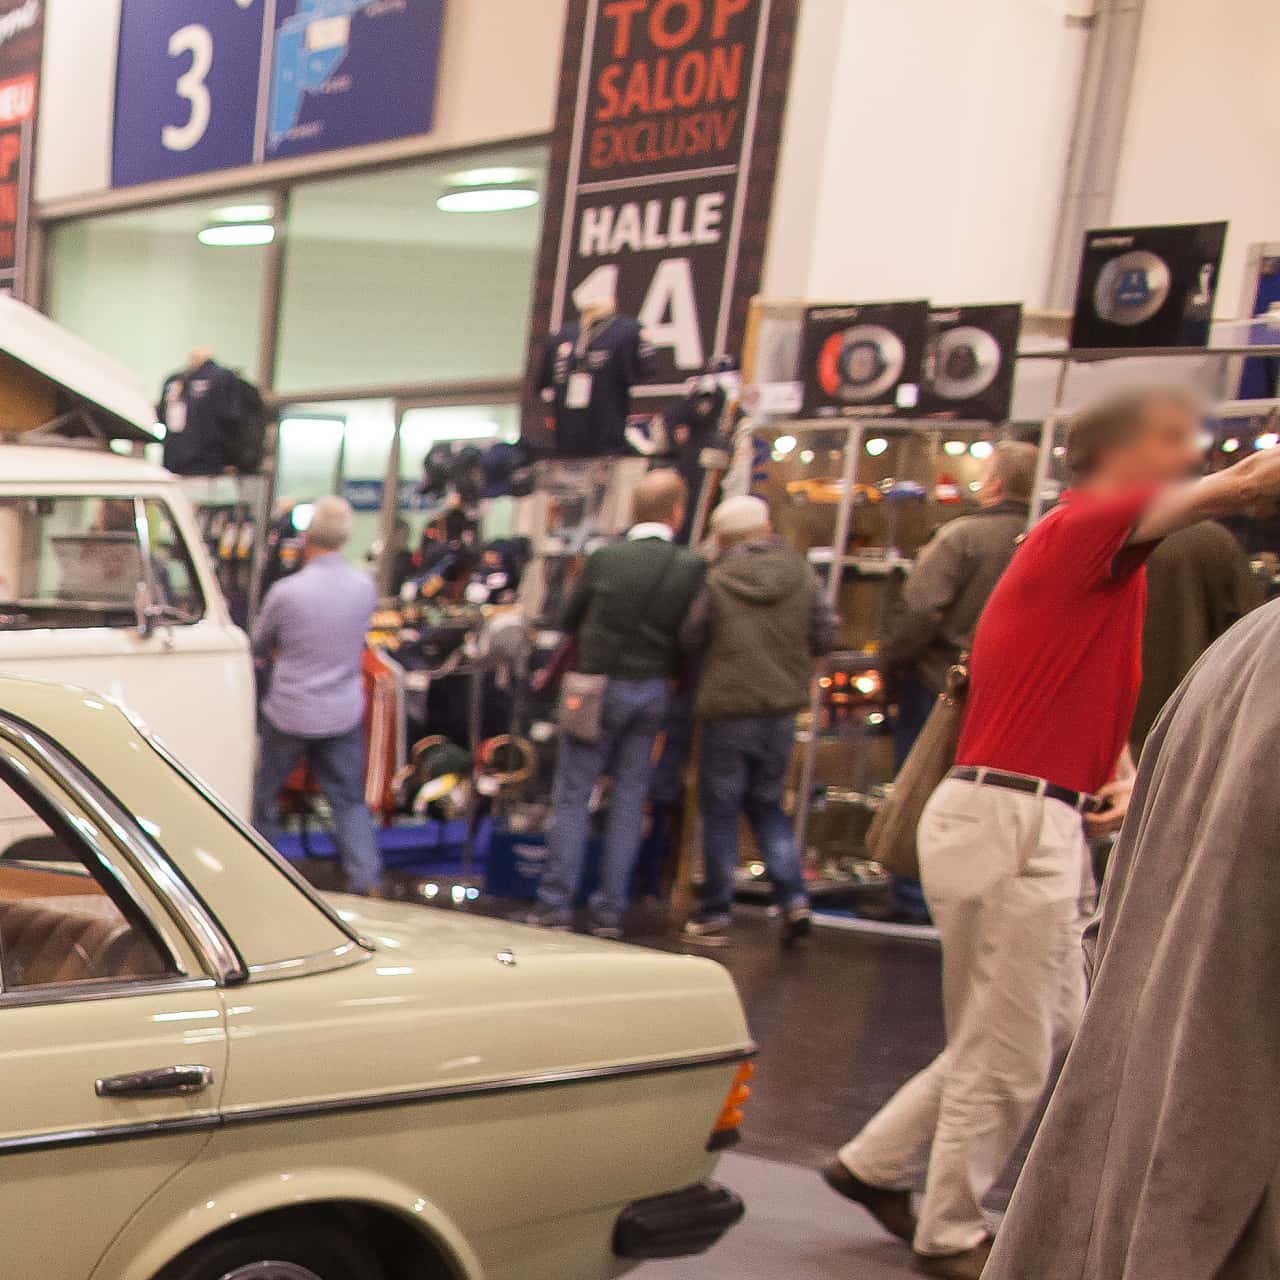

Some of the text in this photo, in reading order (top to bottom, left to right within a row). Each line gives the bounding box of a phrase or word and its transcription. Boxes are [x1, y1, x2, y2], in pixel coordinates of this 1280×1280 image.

[602, 0, 751, 58] TOP
[161, 24, 214, 152] 3
[596, 42, 746, 123] SALON
[590, 109, 738, 170] EXCLUSIV
[579, 191, 725, 258] HALLE
